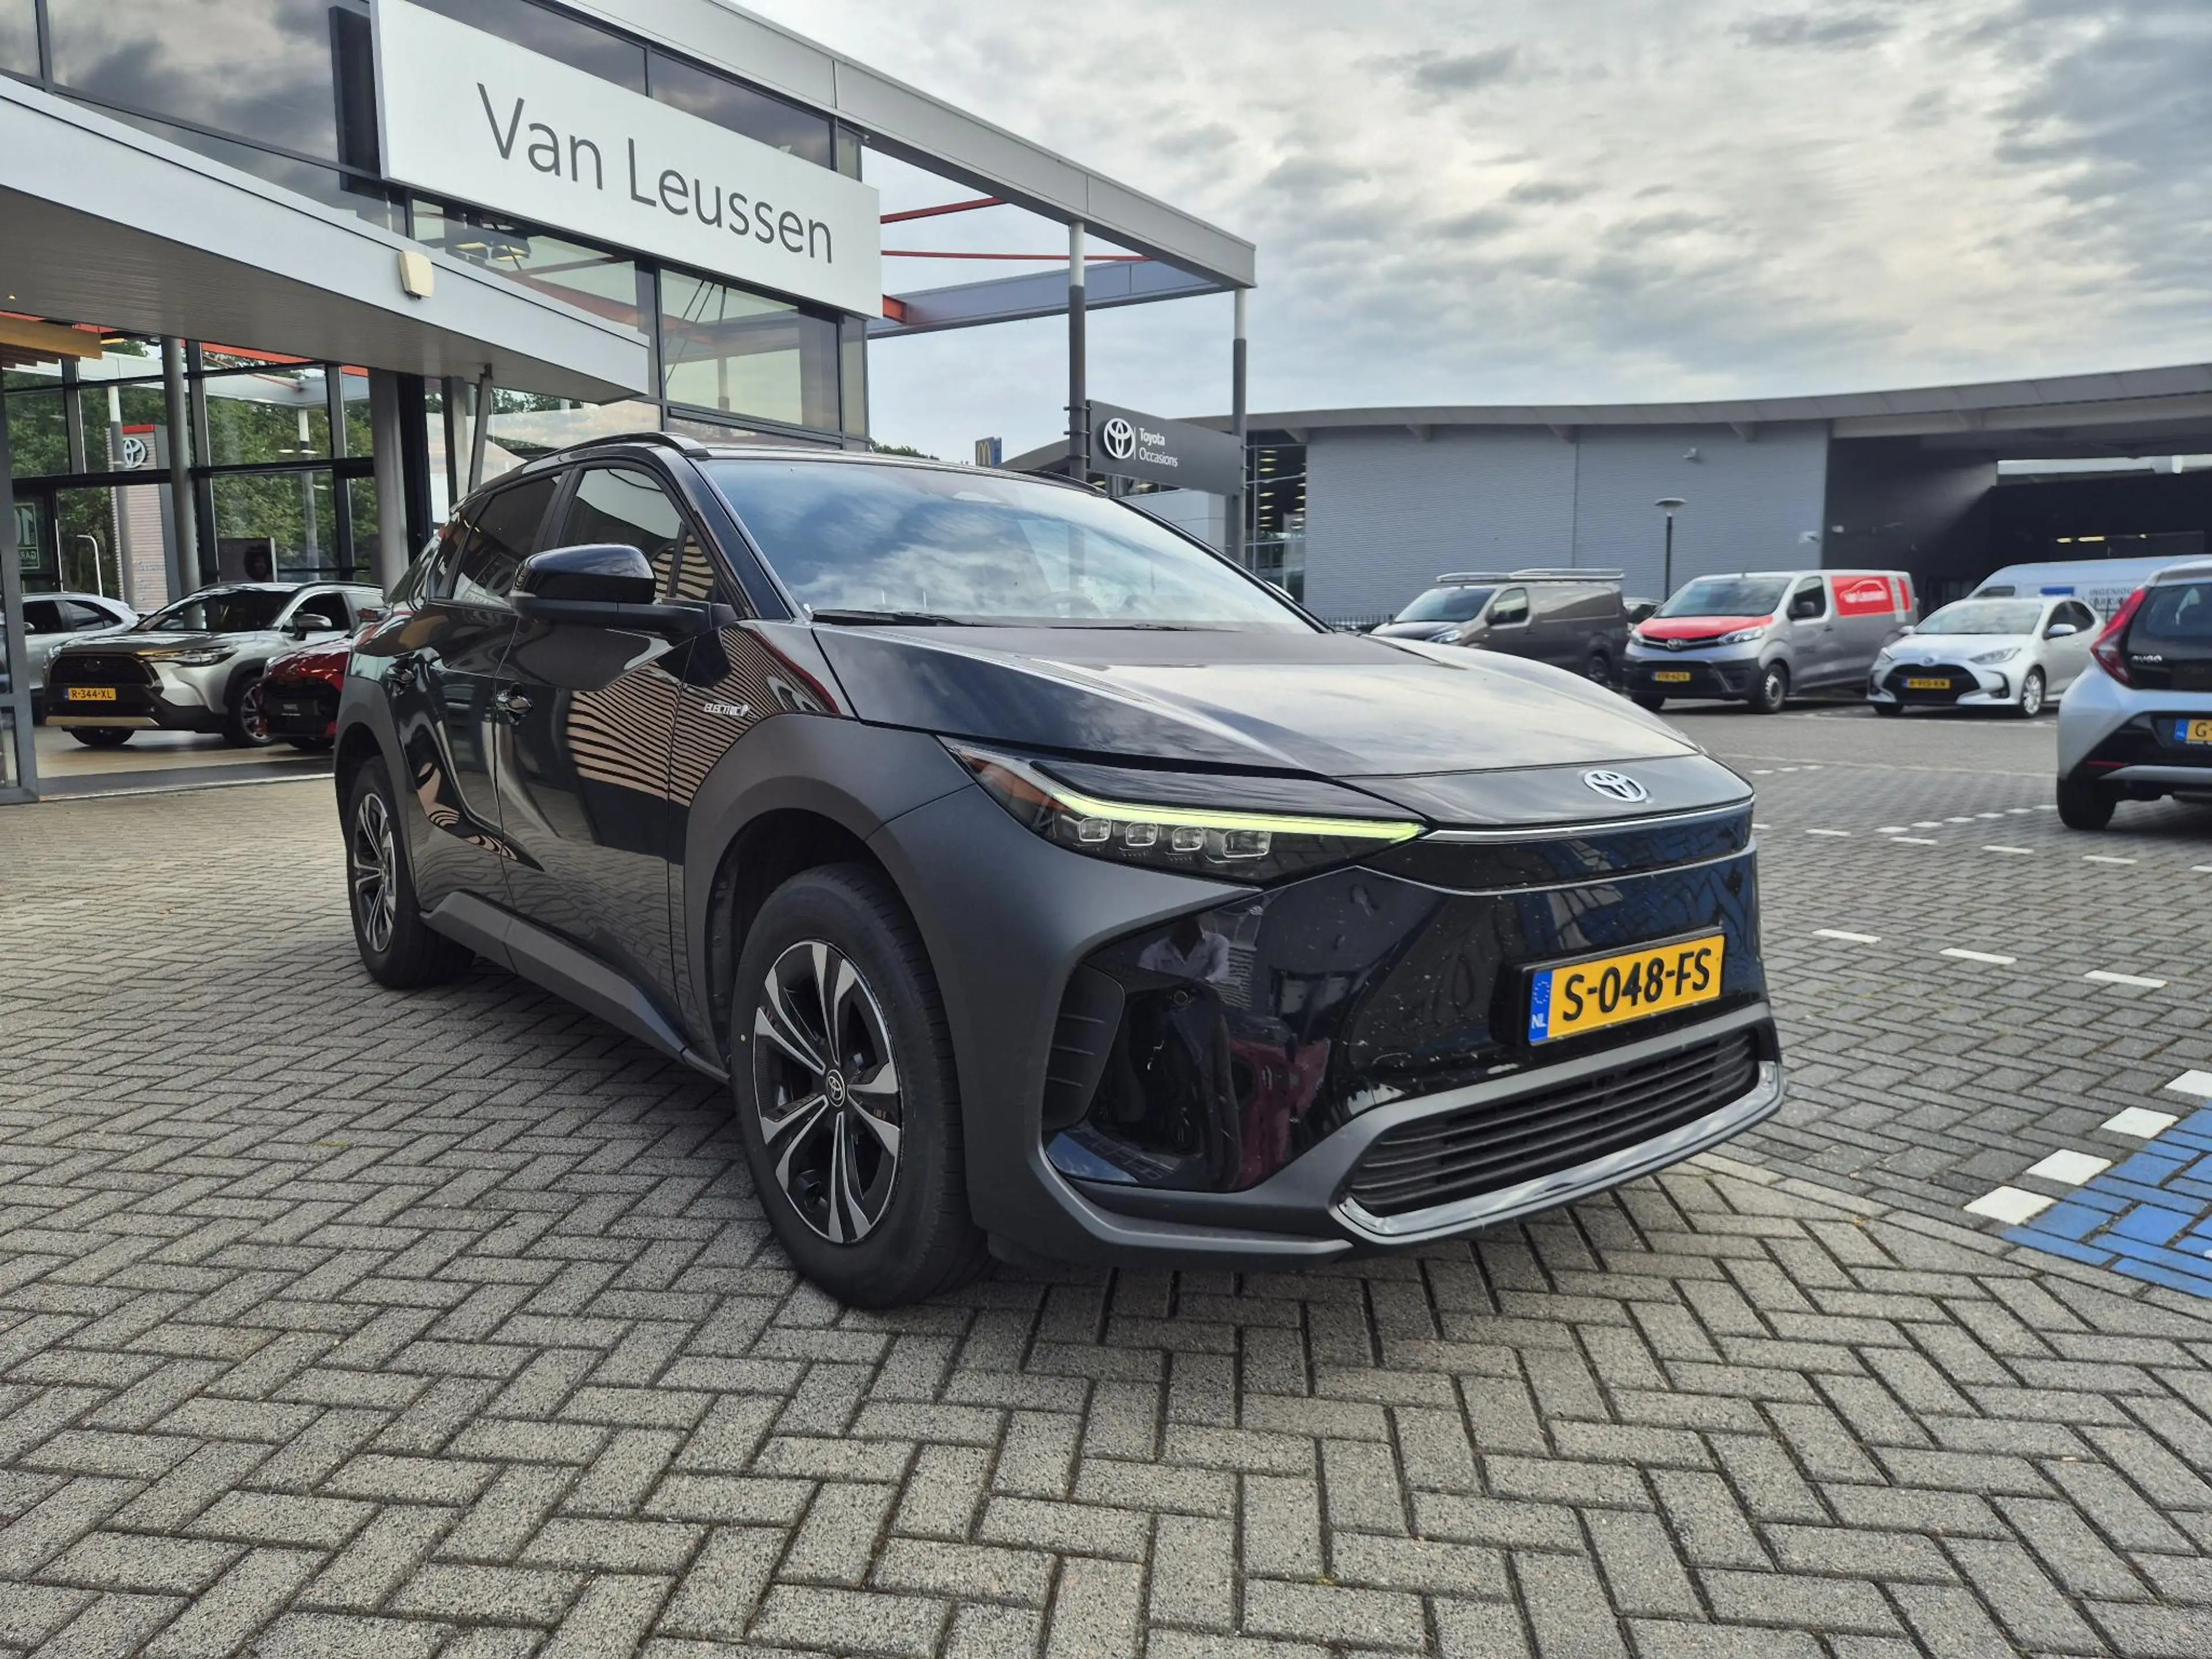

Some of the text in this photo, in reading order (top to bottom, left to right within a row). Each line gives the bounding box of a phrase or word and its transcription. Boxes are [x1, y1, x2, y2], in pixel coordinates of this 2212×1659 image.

[477, 82, 832, 264] Van Leussen
[1139, 427, 1165, 446] Toyota
[1139, 447, 1178, 467] Occasions
[71, 688, 113, 699] R-344-XL
[1531, 947, 1713, 1029] NL S-048-FS
